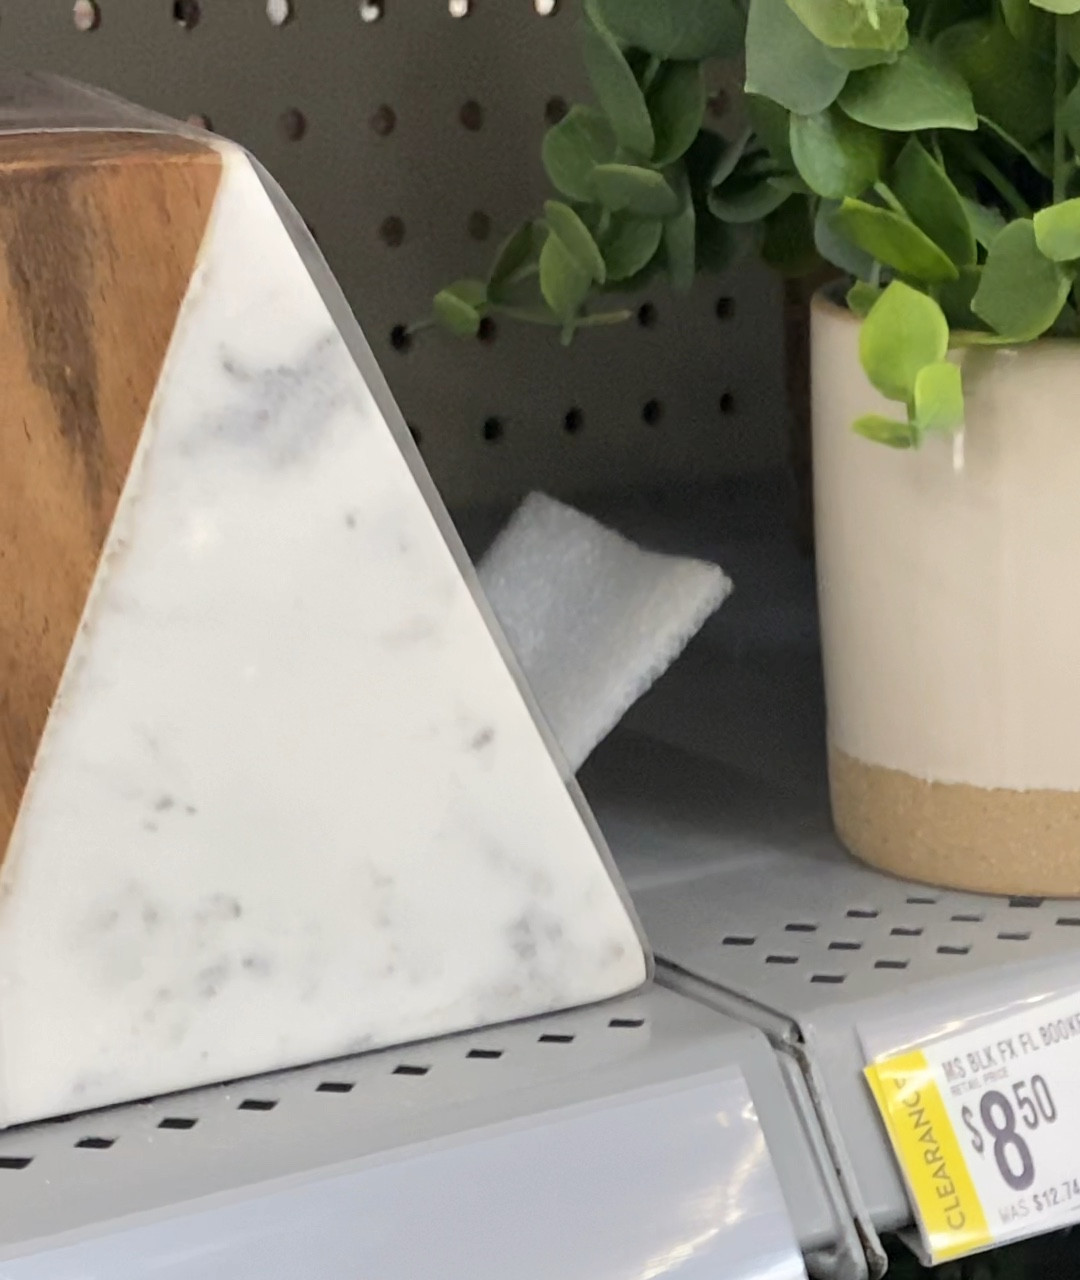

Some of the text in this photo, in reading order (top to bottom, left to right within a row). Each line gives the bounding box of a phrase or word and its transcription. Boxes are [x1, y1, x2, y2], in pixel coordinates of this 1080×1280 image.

[969, 1046, 998, 1074] BLK
[998, 1037, 1021, 1064] FX
[1020, 1030, 1038, 1054] FL
